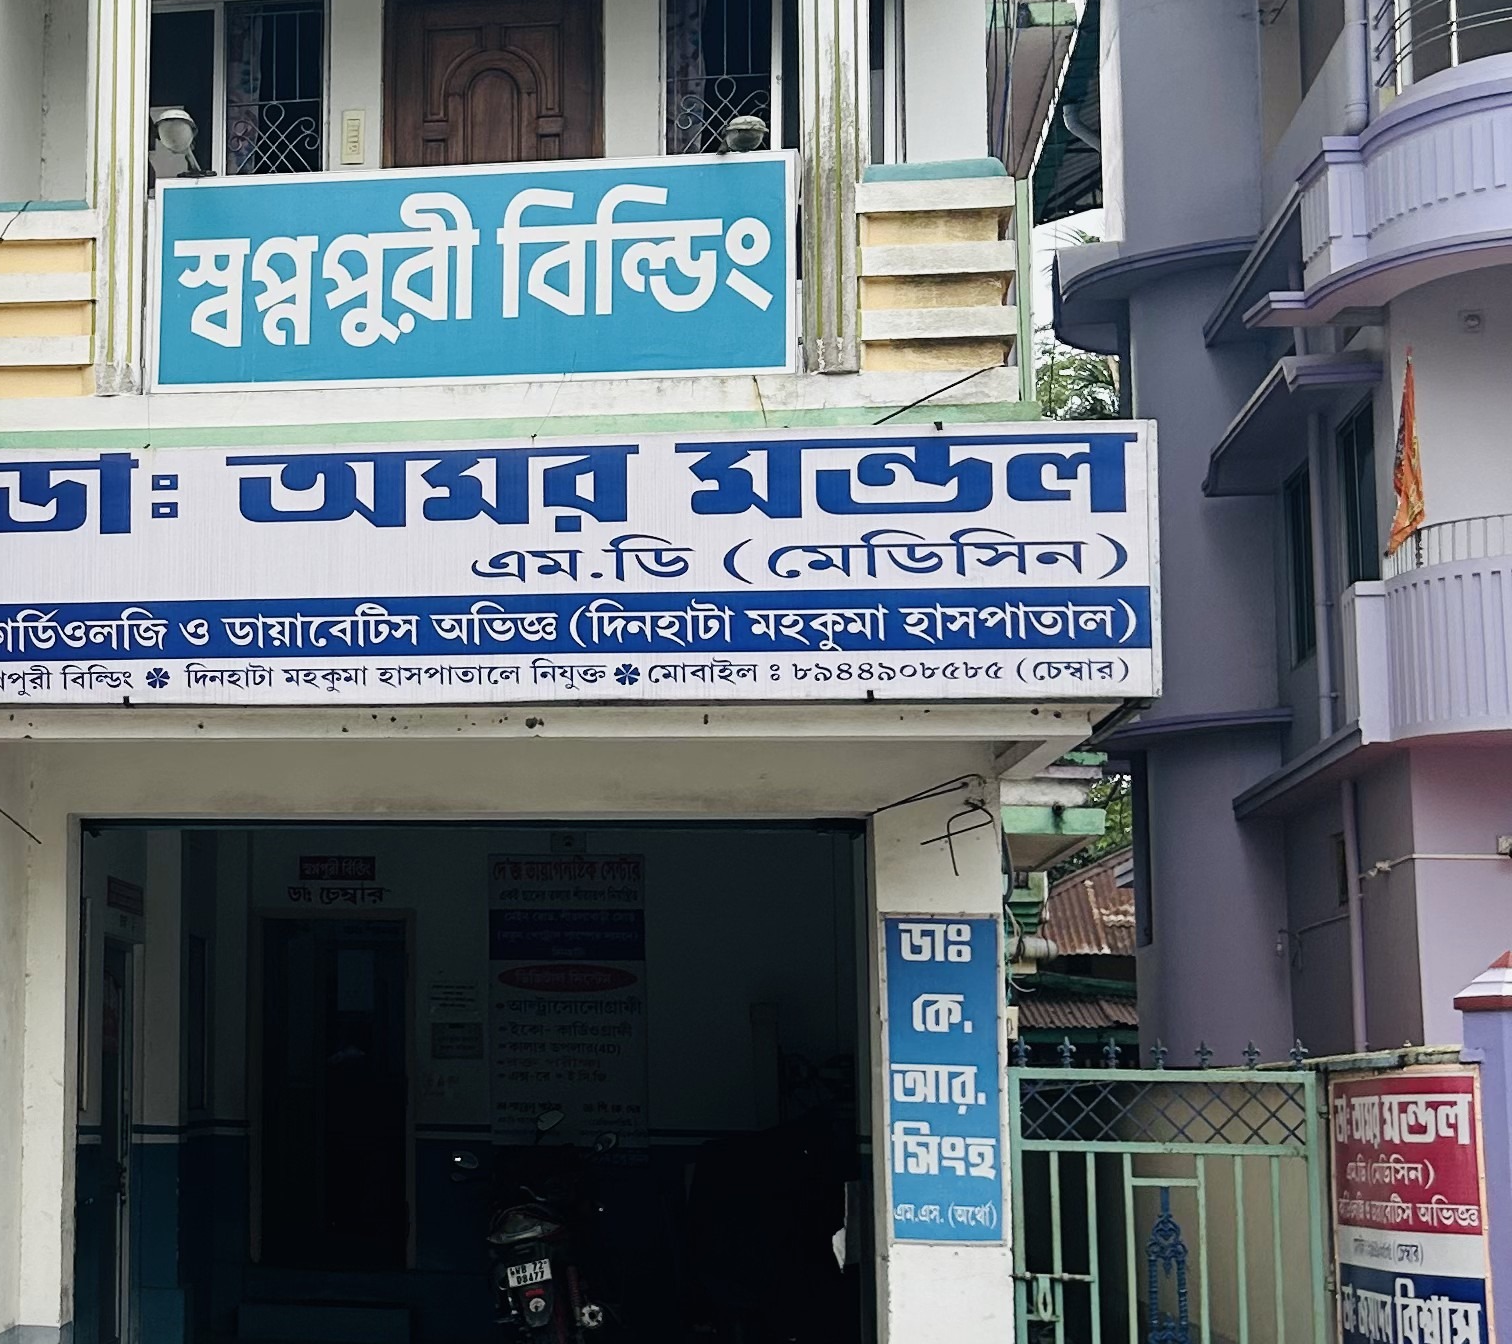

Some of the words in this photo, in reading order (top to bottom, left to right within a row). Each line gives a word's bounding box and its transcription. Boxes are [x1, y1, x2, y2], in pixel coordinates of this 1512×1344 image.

[174, 191, 480, 348] স্বপ্নপুরী
[496, 184, 774, 318] বিল্ডিং
[225, 443, 639, 534] অমর
[179, 618, 210, 648] ও
[221, 603, 421, 651] ডায়াবেটিস
[428, 599, 558, 646] অভিজ্ঞ
[568, 597, 734, 650] (দিনহাটা
[744, 602, 889, 652] মহকুমা
[899, 598, 1136, 645] হাসপাতাল)
[60, 664, 134, 692] বিল্ডিং
[184, 662, 274, 690] দিনহাটা
[283, 665, 367, 694] মহকুমা
[378, 662, 523, 690] হাসপাতালে
[530, 658, 606, 690] নিযুক্ত
[647, 660, 757, 686] মোবাইল
[791, 662, 1004, 683] ৮৯৪৪৯০৮৫৮৫
[1015, 657, 1130, 685] (চেম্বার)
[892, 1121, 996, 1180] সিংহ
[1416, 1194, 1479, 1227] অভিজ্ঞ
